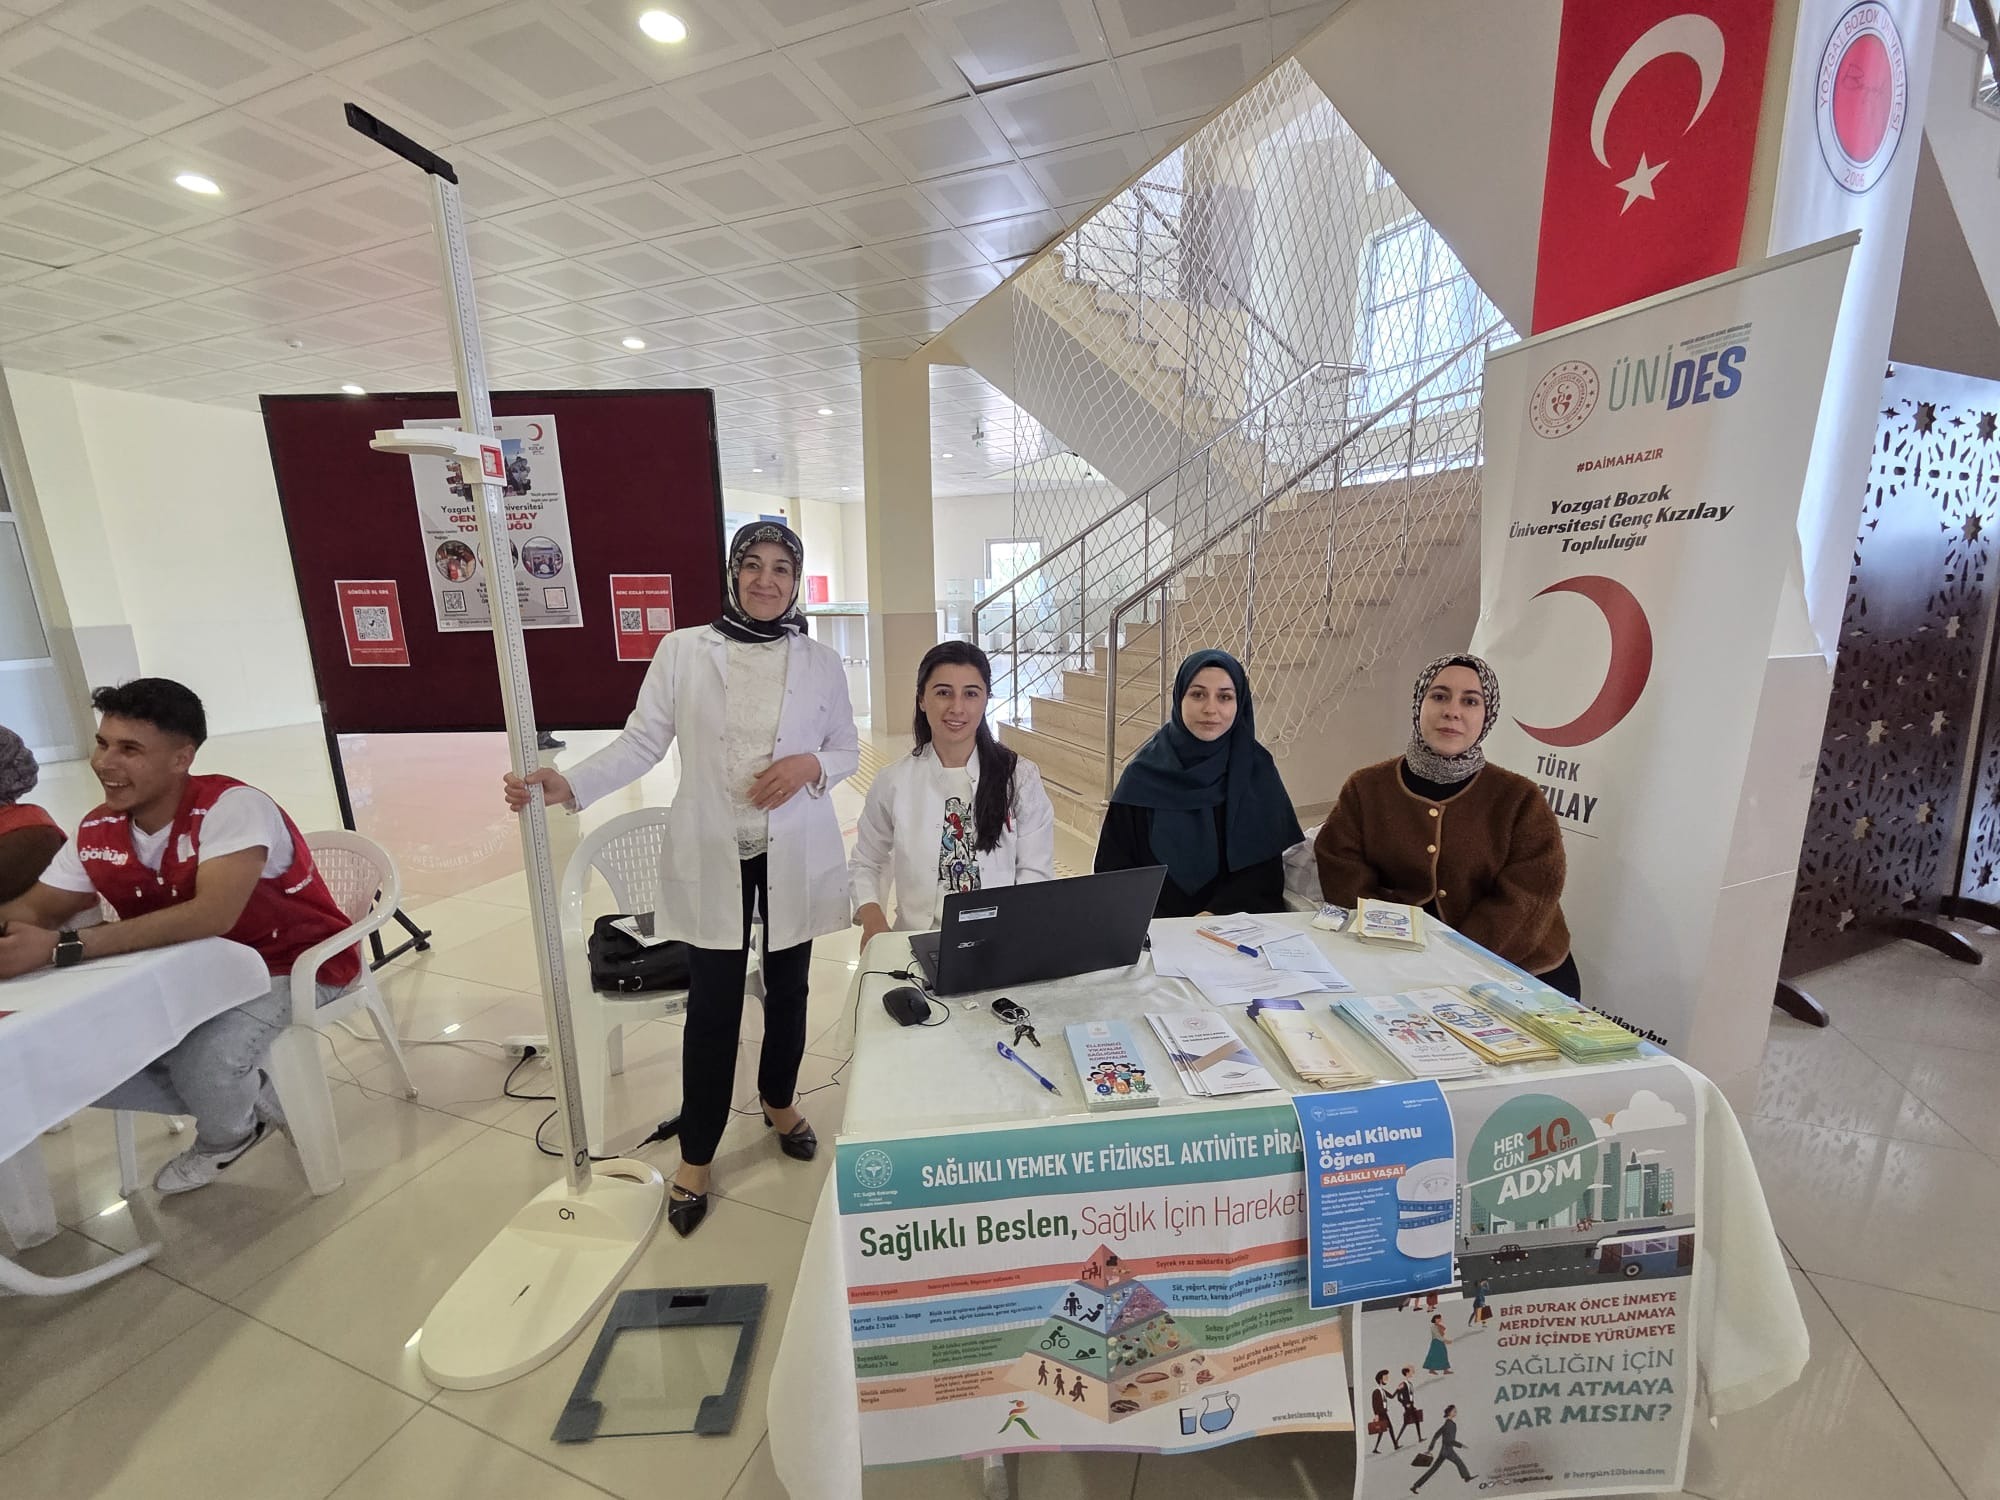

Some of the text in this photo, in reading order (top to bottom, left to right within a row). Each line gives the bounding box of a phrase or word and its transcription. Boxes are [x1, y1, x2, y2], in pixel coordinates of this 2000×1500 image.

[1820, 32, 1846, 108] YOZGAT
[1844, 8, 1879, 36] BOZOK
[441, 505, 472, 515] Yozgat
[504, 502, 544, 511] niversitesi
[1551, 484, 1672, 516] Yozgat Bozok
[449, 514, 476, 523] GEN
[1509, 502, 1736, 539] Üniversitesi Genç Kızılay
[1561, 531, 1648, 555] Topluluğu
[1536, 753, 1581, 782] TÜRK
[1315, 1125, 1423, 1150] İdeal Kilonu
[1494, 1117, 1578, 1162] HER 10 bin
[921, 1128, 1304, 1188] SAĞLIKLI YEMEK VE FİZİKSEL AKTİVİTE PİRA
[1319, 1150, 1376, 1171] Öğren
[1493, 1151, 1525, 1172] GÜN
[1323, 1167, 1405, 1186] SAĞLIKLI YAŞA!
[860, 1217, 966, 1261] Sağlıklı
[976, 1208, 1078, 1245] Beslen,
[1081, 1201, 1157, 1241] Sağlık
[1164, 1196, 1206, 1237] İçin
[1215, 1188, 1305, 1227] Hareket
[1500, 1291, 1677, 1317] BİR DURAK ÖNCE İNMEYE
[1499, 1306, 1676, 1332] MERDİVEN KULLANMAYA
[1497, 1323, 1676, 1348] GÜN İÇİNDE YÜRÜMEYE
[1495, 1347, 1675, 1377] SAĞLIĞIN İÇİN
[1494, 1377, 1674, 1404] ADIM ATMAYA
[1495, 1403, 1673, 1433] VAR MISIN?
